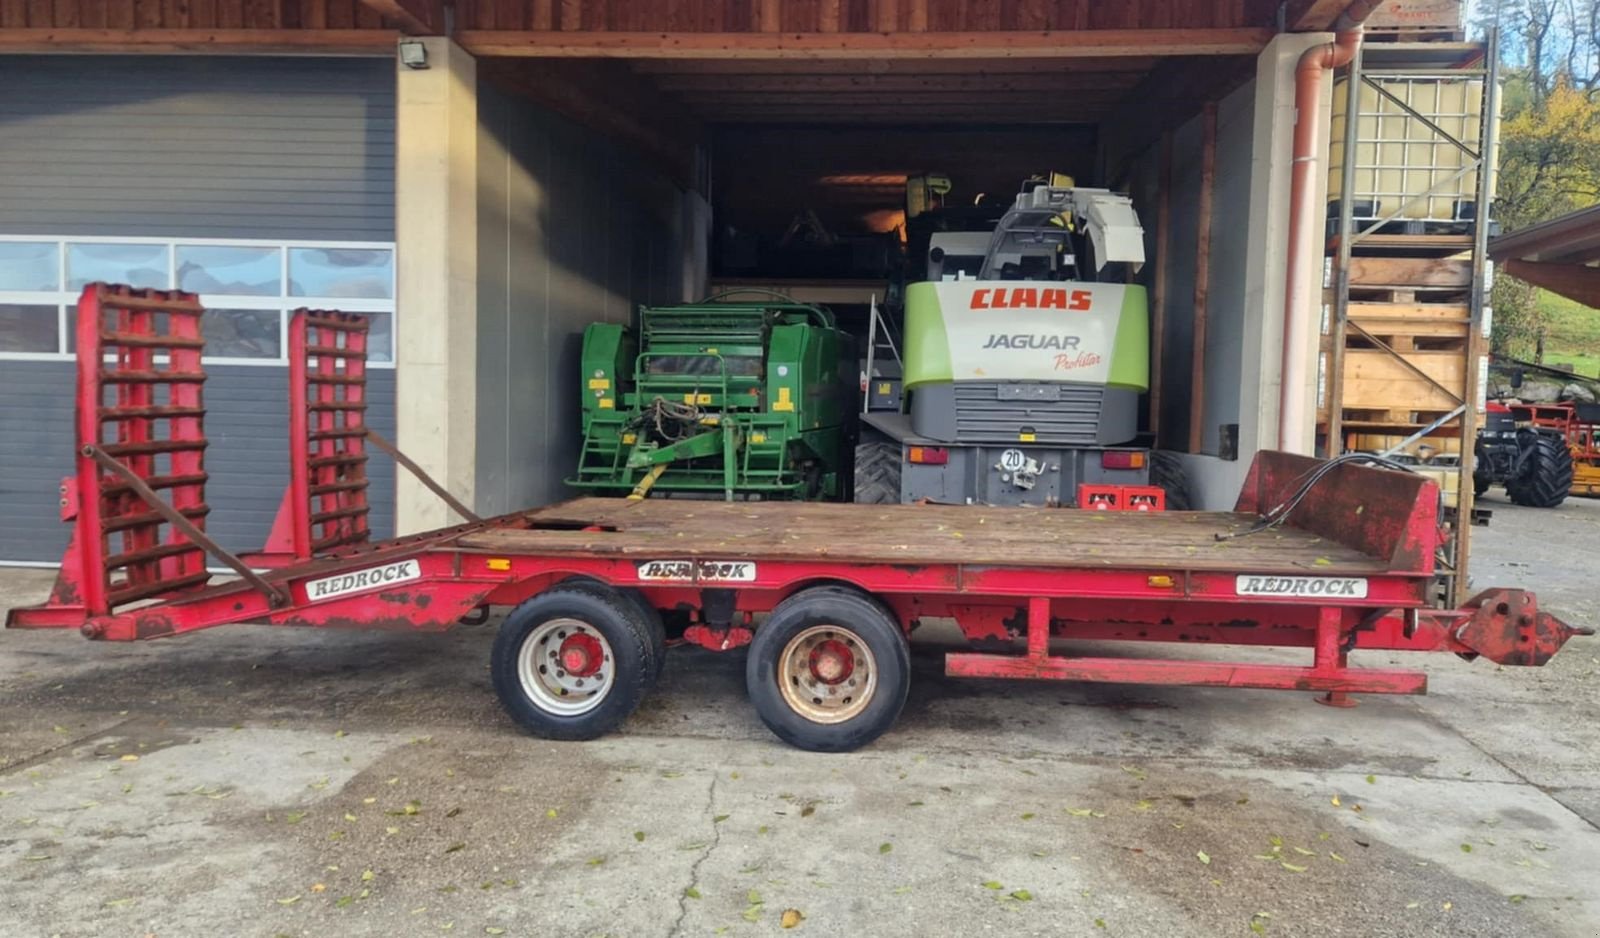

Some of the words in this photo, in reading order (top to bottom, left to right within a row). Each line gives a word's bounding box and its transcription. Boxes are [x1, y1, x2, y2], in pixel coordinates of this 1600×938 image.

[970, 288, 1092, 311] CLAAS
[982, 334, 1081, 350] JAGUAR
[1054, 351, 1101, 371] Profistar
[1006, 451, 1021, 467] 20
[315, 562, 411, 597] REDROCK
[1243, 577, 1359, 595] REDROCK
